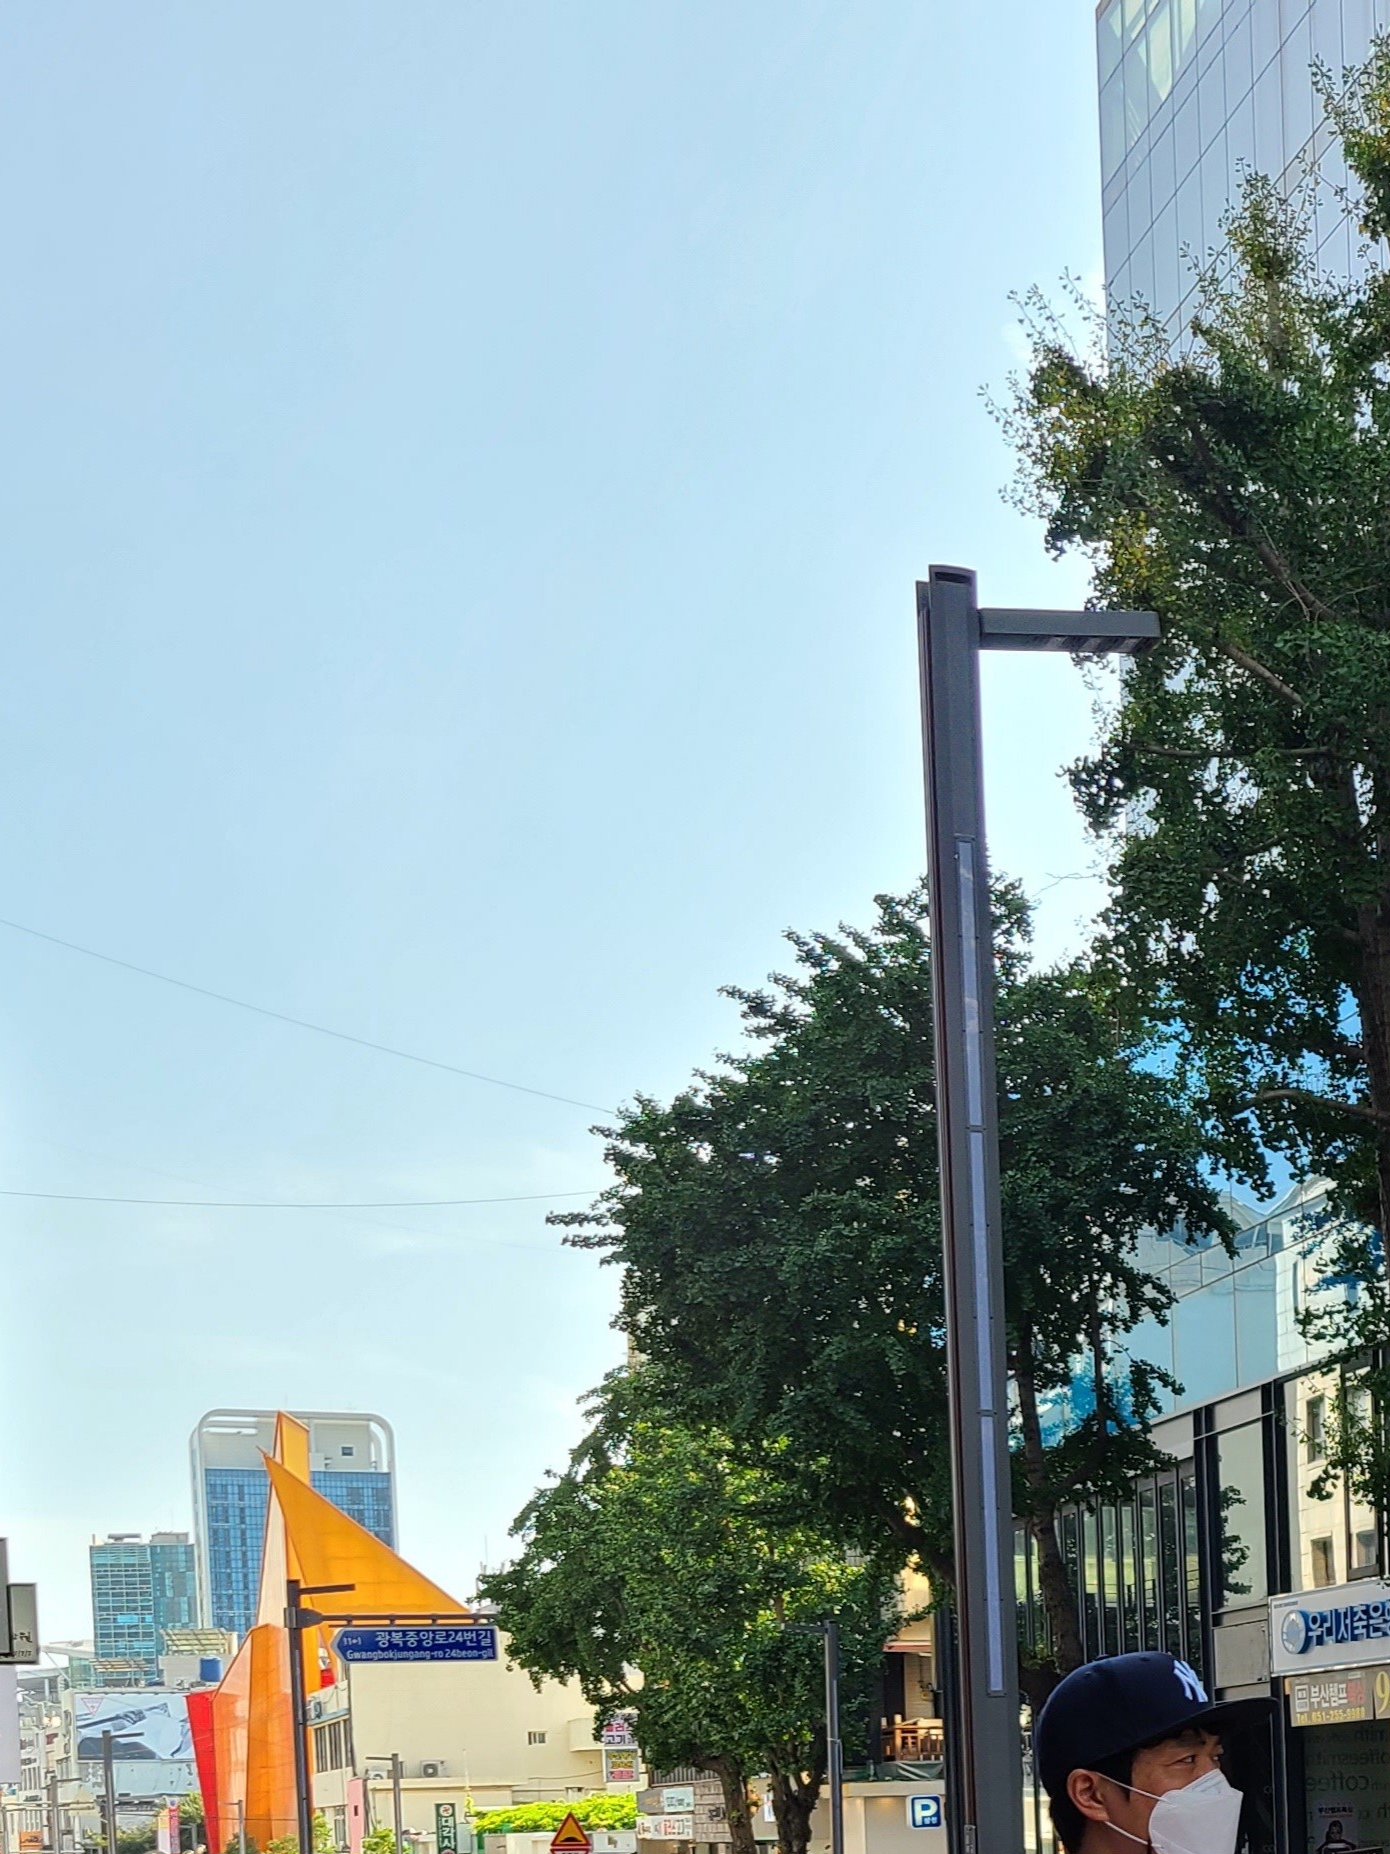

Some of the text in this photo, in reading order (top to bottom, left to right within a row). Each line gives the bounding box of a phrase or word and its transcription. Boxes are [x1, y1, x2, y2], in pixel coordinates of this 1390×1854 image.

[375, 1630, 493, 1647] 광복중앙로24번길
[346, 1648, 494, 1660] Gwangbokjungang-ro 24beon-gil
[913, 1798, 938, 1827] P
[442, 1816, 456, 1849] 대각사
